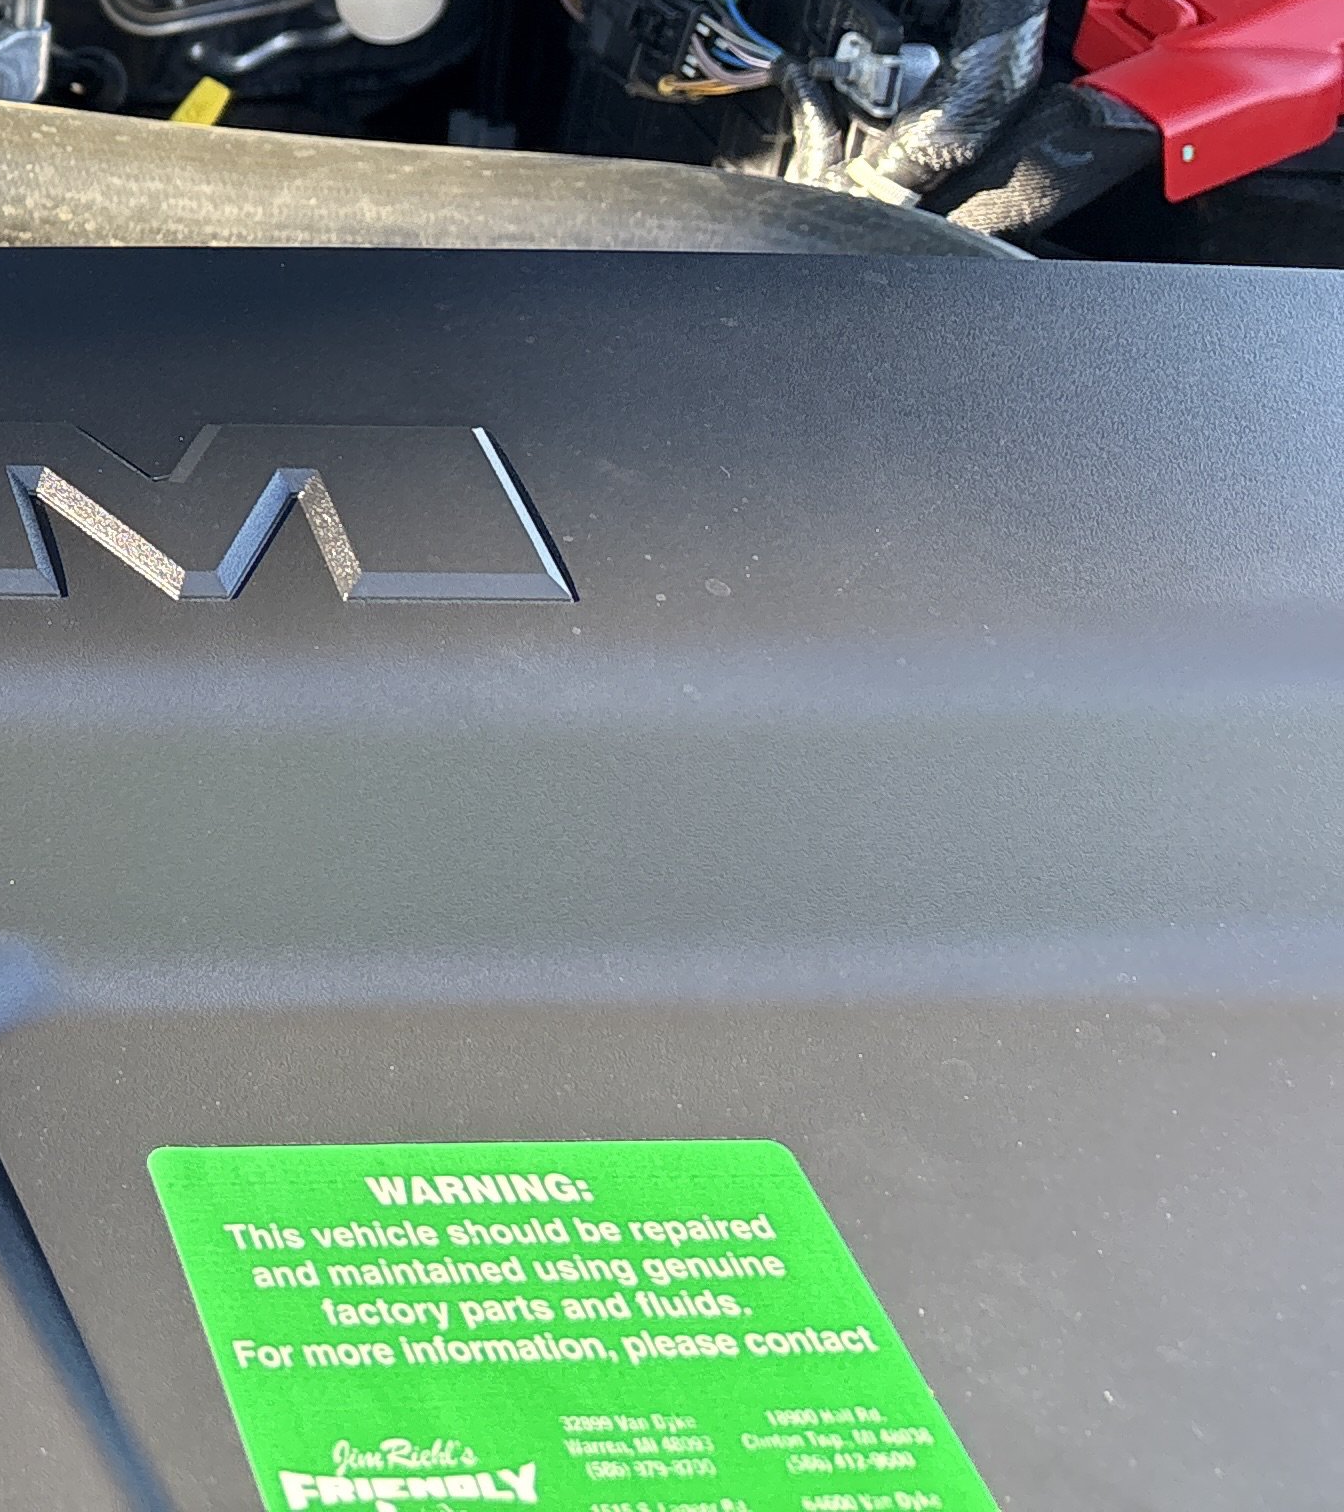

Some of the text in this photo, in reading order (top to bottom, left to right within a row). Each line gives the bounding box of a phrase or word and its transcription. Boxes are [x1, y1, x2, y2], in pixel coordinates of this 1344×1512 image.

[364, 1173, 594, 1206] WARNING:
[223, 1213, 777, 1250] This vehicle should be repaired
[252, 1251, 787, 1288] and maintained using genuine
[321, 1289, 753, 1331] factory parts and fluids.
[231, 1325, 880, 1369] For more information, please contact
[332, 1439, 383, 1478] Jim
[278, 1460, 539, 1511] FRIENDLY
